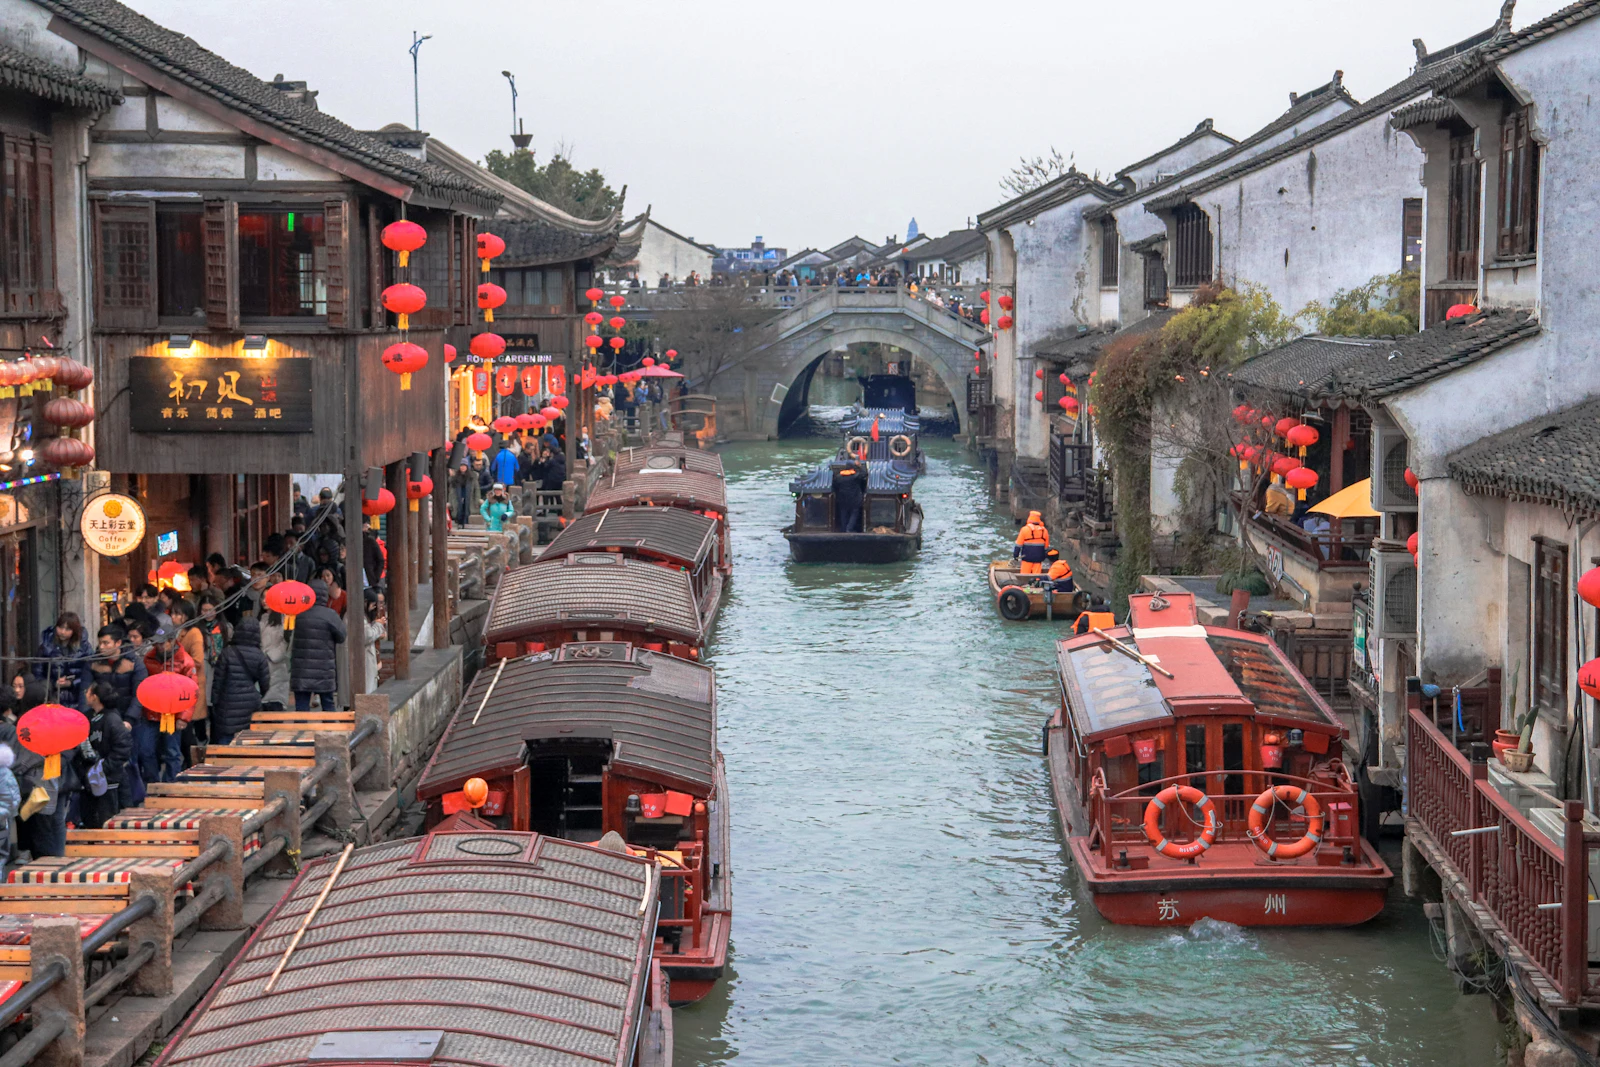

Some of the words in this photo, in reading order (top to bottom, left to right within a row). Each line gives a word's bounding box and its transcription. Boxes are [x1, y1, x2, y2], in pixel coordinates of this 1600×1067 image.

[498, 354, 536, 363] GARDEN
[537, 354, 552, 363] INN
[168, 370, 254, 406] 初见
[161, 407, 189, 419] 音乐
[206, 407, 234, 419] 简餐
[254, 407, 282, 419] 酒吧
[89, 519, 136, 530] 天上彩云堂
[98, 535, 128, 543] Coffee
[1157, 898, 1180, 921] 苏
[1264, 893, 1286, 915] 州
